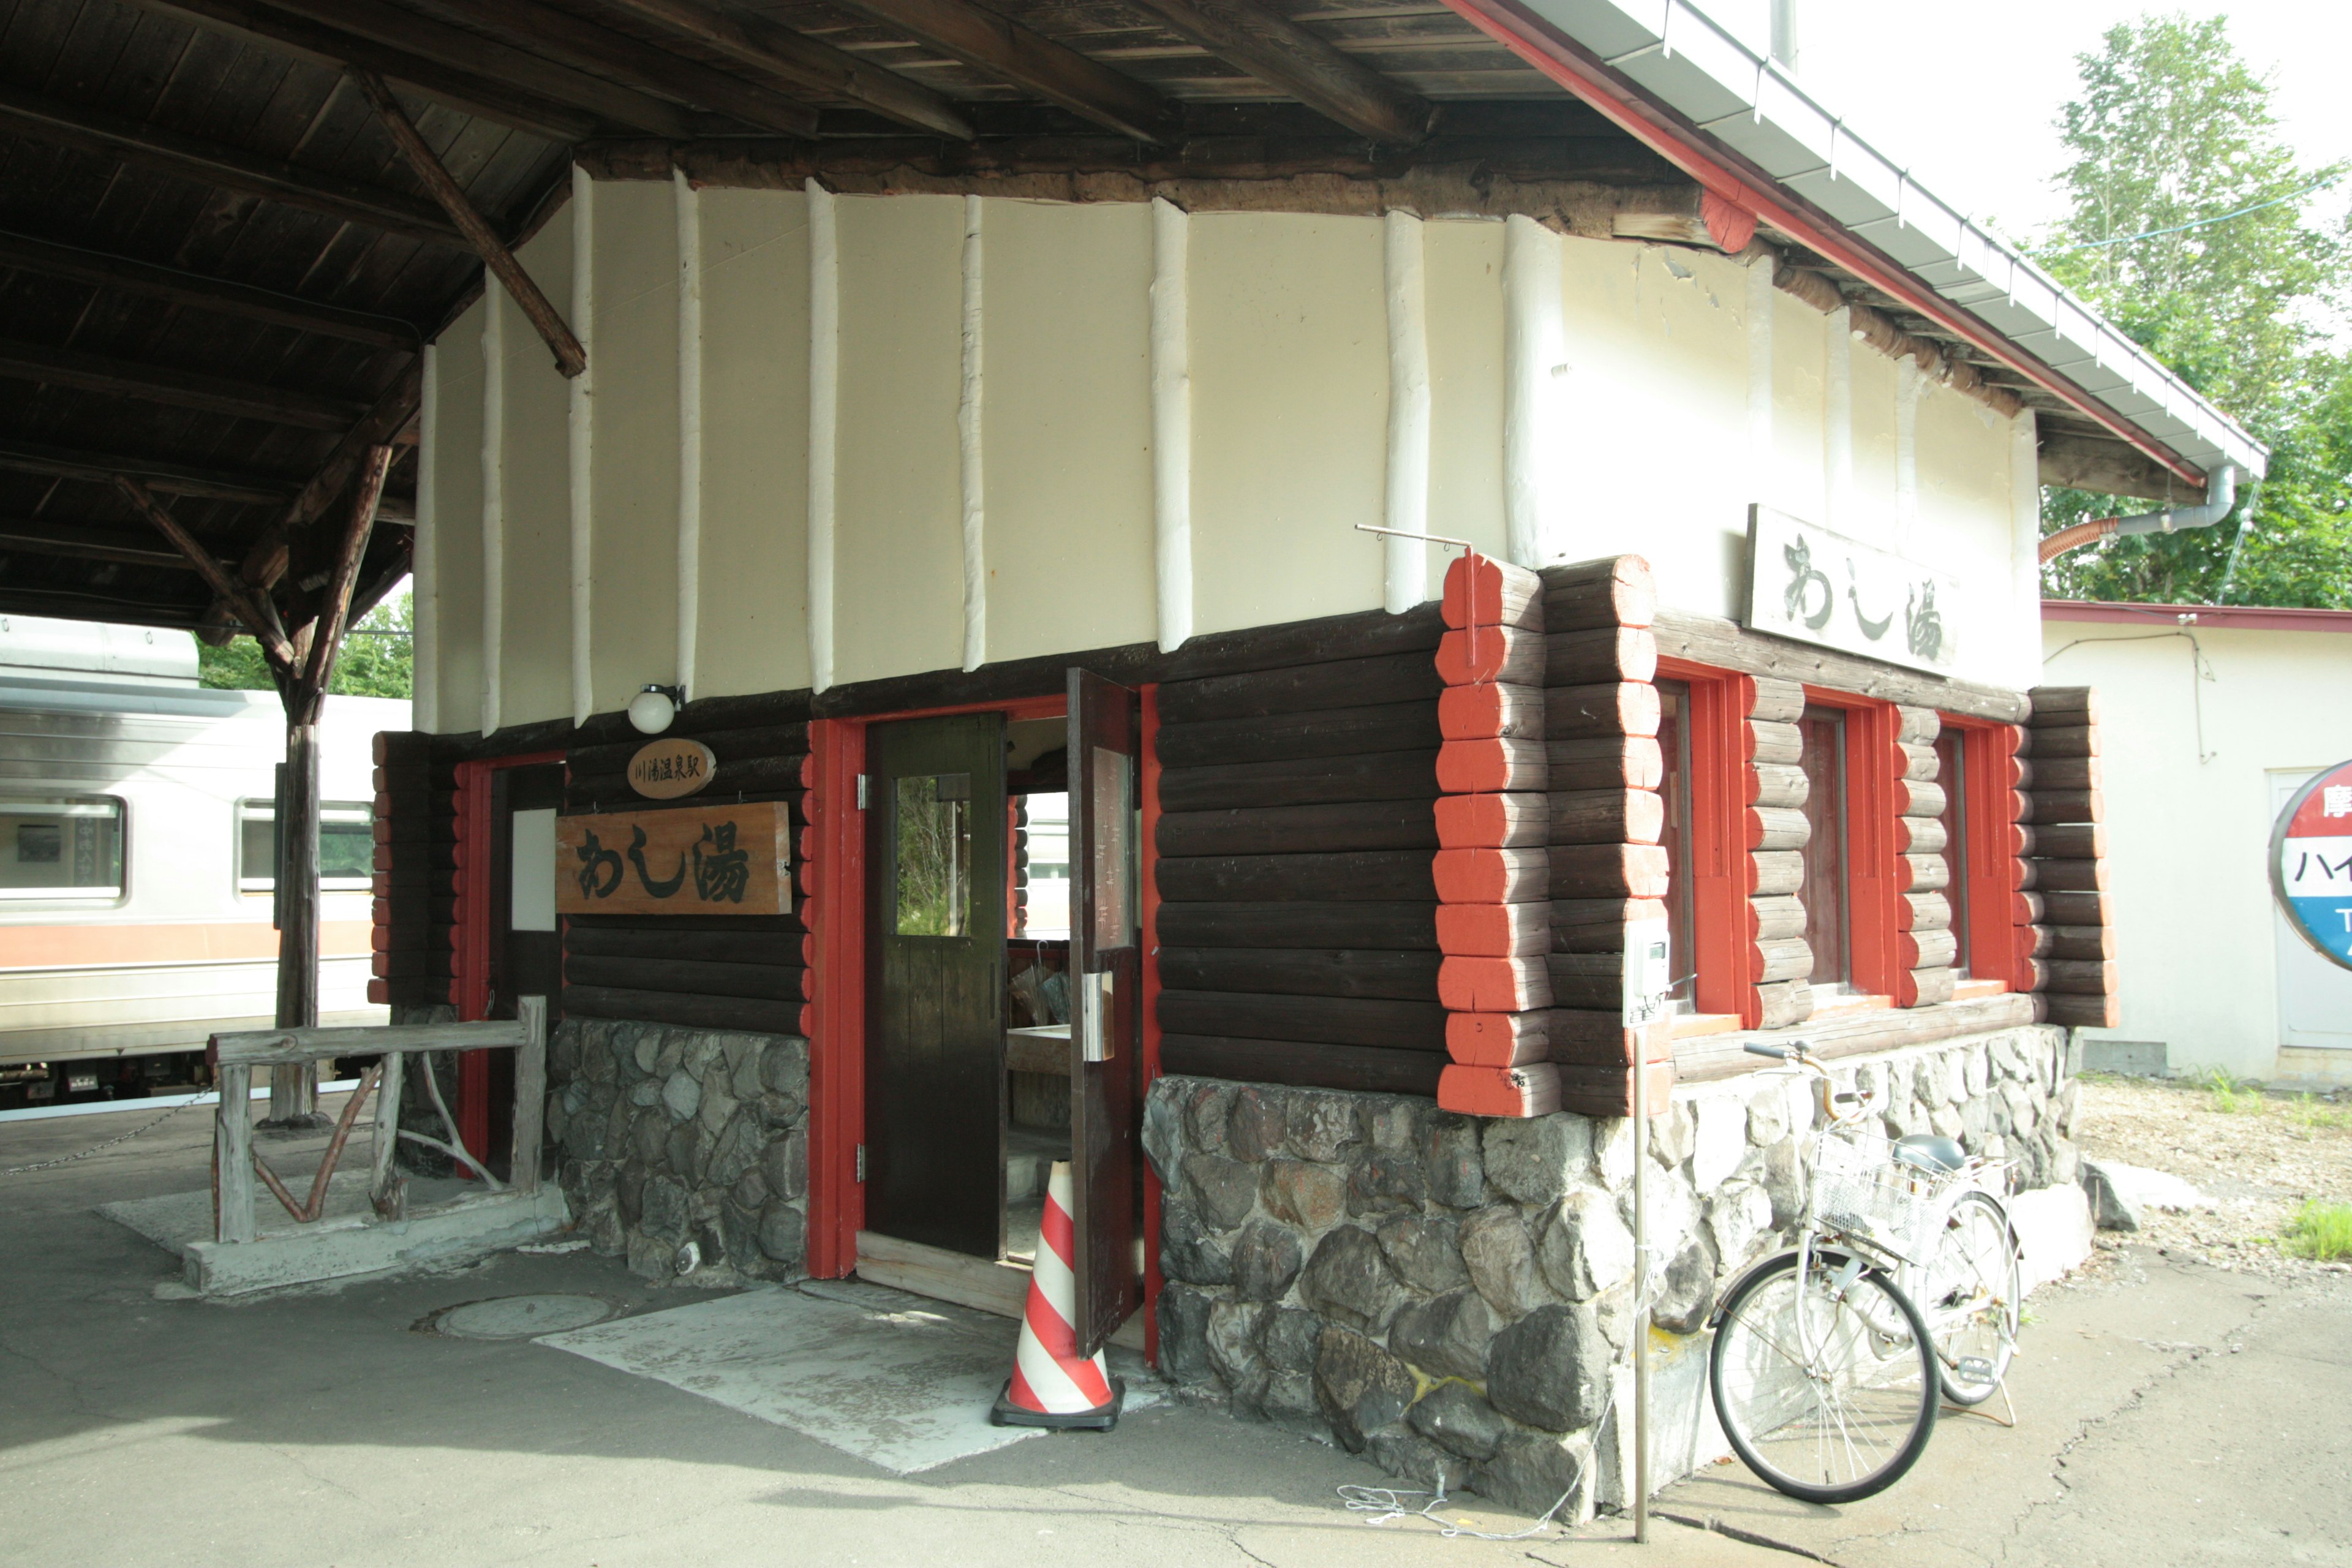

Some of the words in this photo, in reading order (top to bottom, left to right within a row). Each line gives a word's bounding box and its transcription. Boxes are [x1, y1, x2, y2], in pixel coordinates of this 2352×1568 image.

[1784, 533, 1942, 661] あし湯
[635, 754, 701, 783] 川湯温泉駅
[576, 821, 750, 904] あし湯
